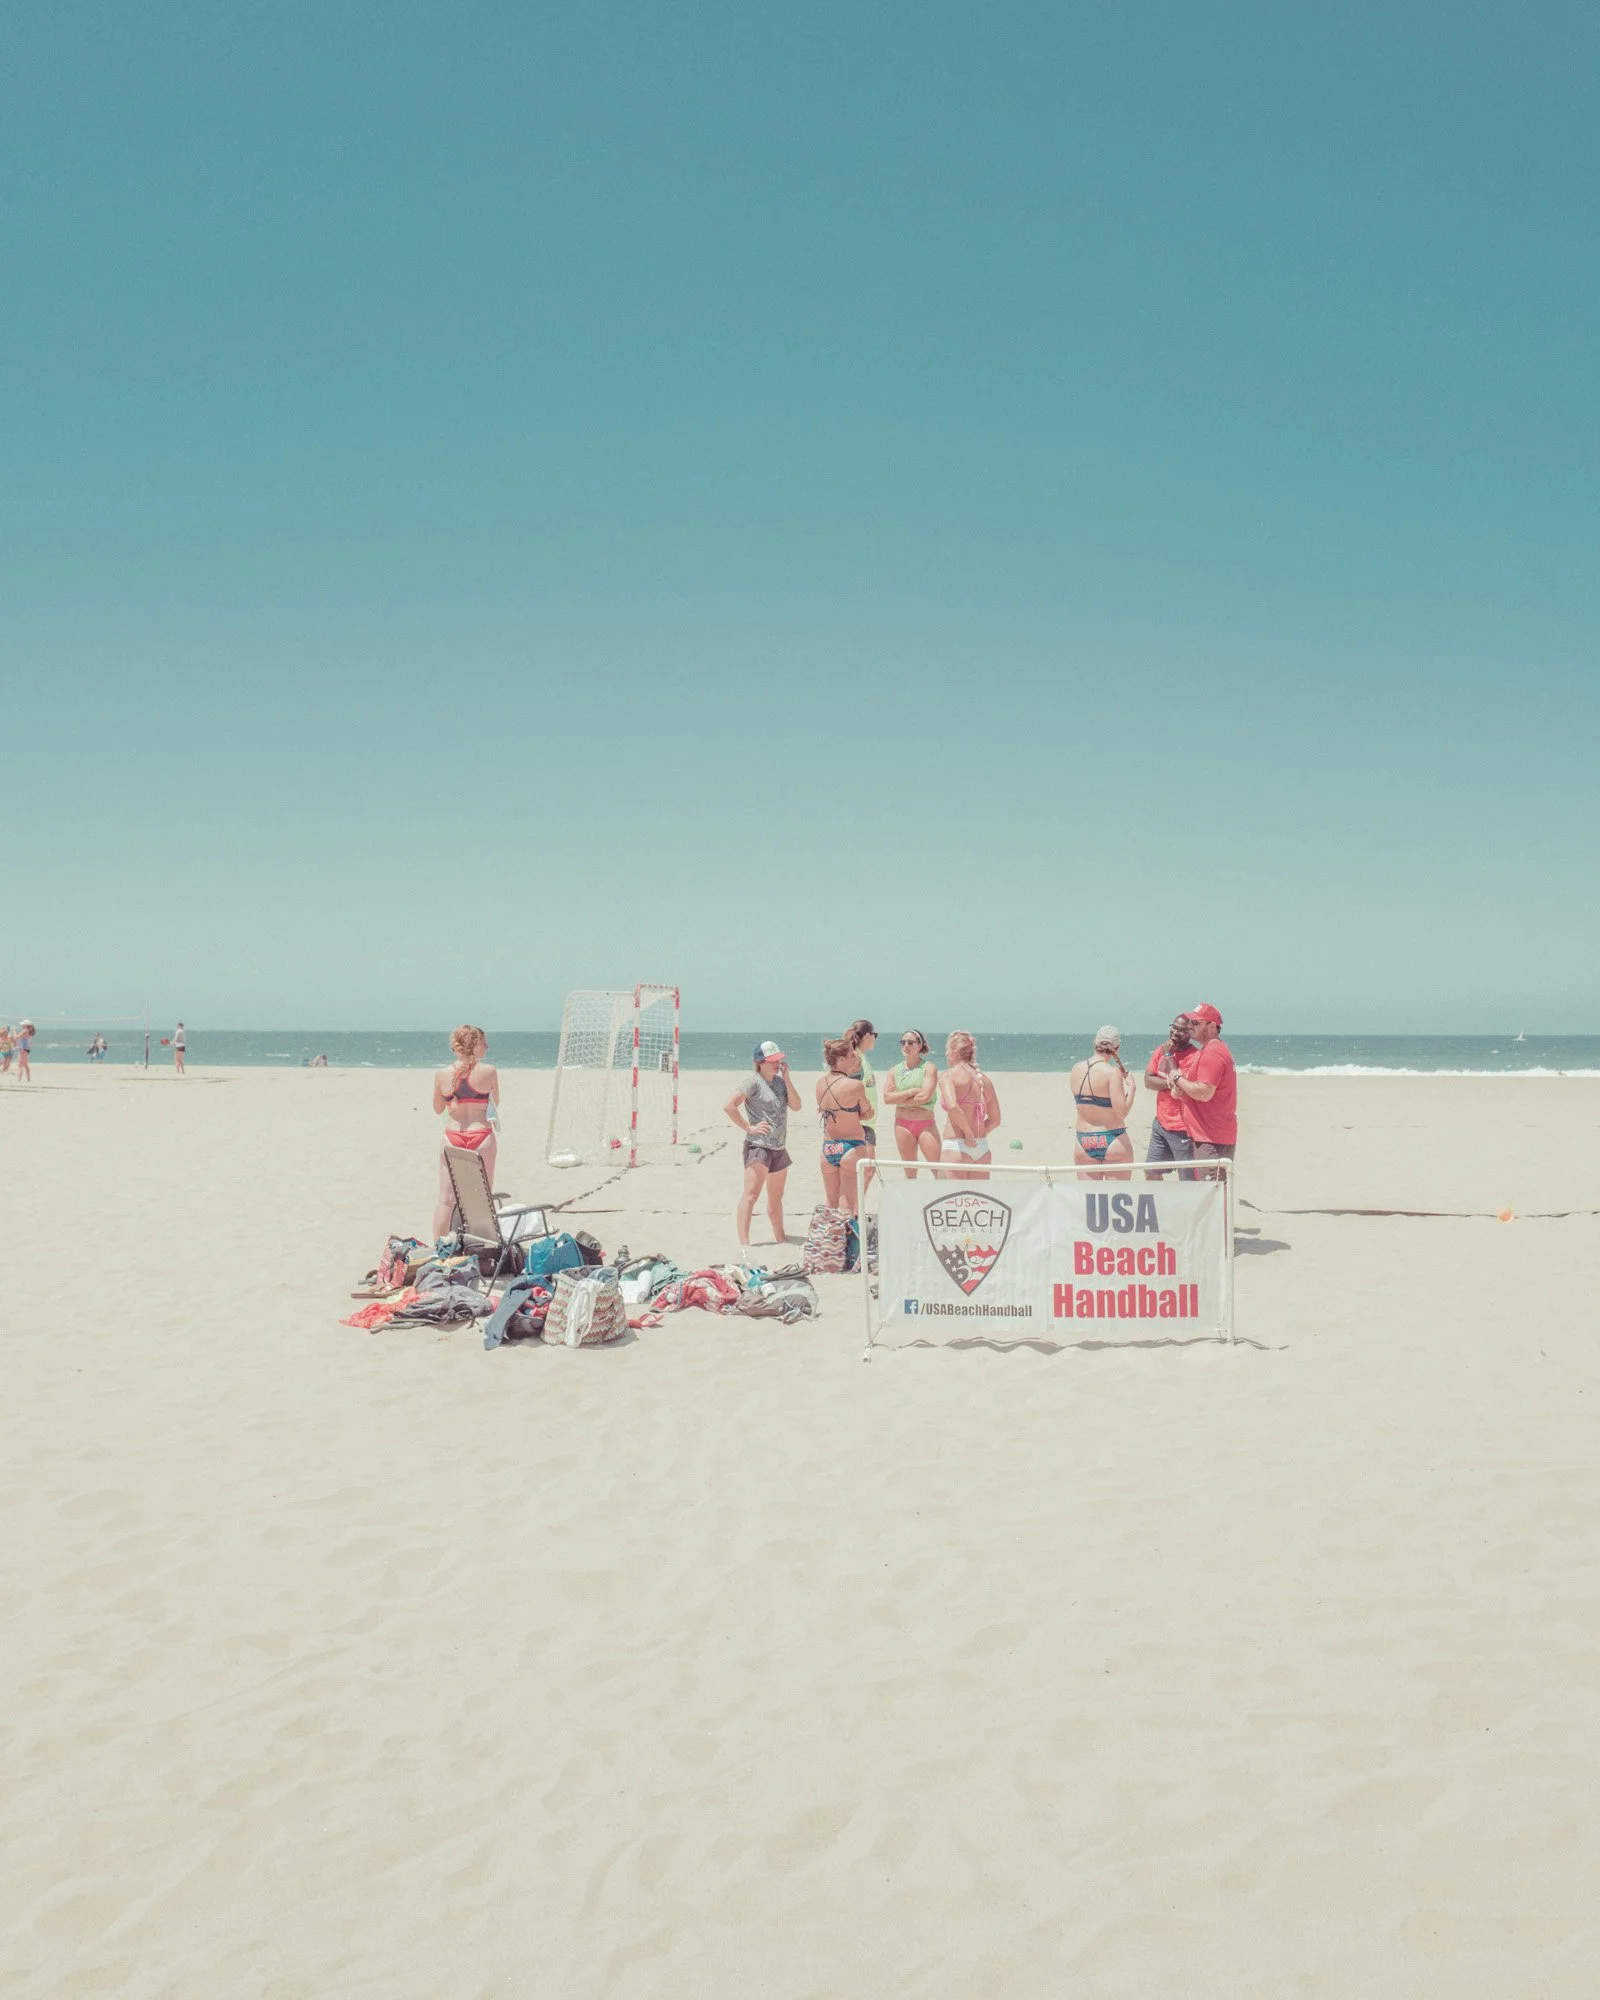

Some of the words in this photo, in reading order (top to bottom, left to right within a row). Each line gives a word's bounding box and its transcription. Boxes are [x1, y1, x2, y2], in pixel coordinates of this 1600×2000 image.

[1081, 1135, 1107, 1149] USA
[954, 1197, 981, 1208] USA
[1085, 1192, 1160, 1234] USA
[929, 1209, 1005, 1228] BEACH
[1073, 1241, 1177, 1276] Beach
[1053, 1283, 1199, 1319] Handball
